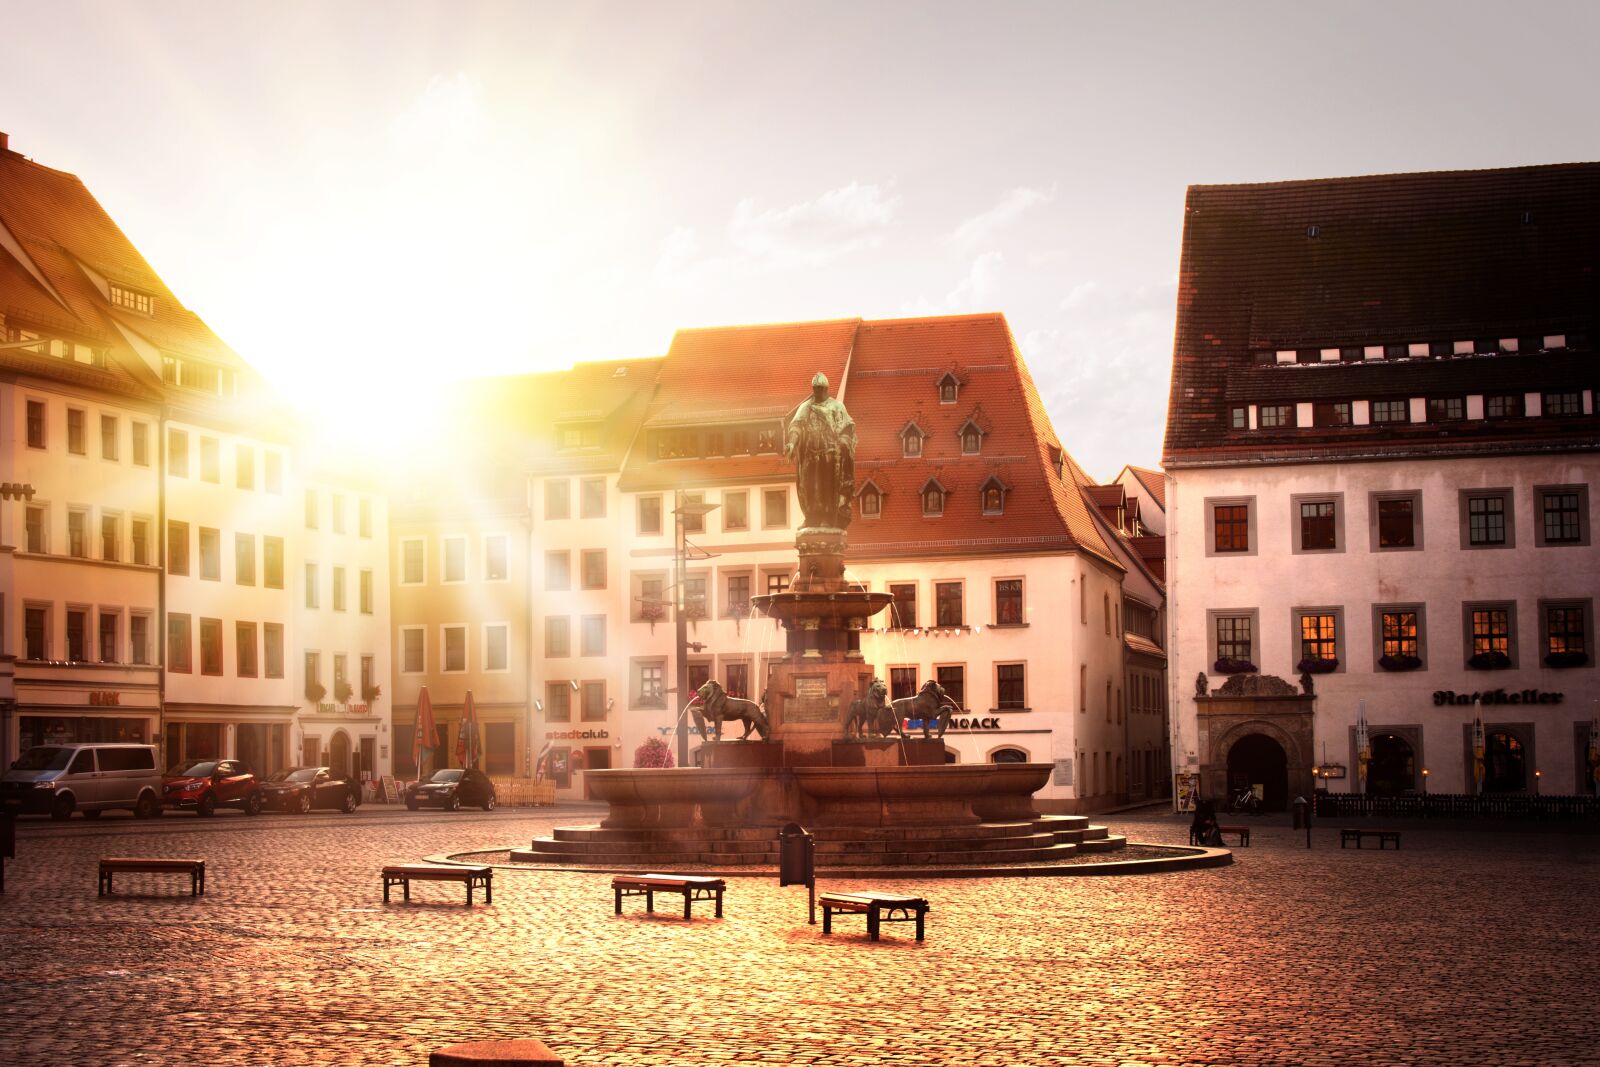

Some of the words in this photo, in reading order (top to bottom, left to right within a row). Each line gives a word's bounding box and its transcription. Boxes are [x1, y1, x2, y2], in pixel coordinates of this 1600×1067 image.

[1432, 688, 1564, 706] Ratskeller
[948, 718, 1000, 729] NOACK
[545, 729, 609, 740] stadtclub
